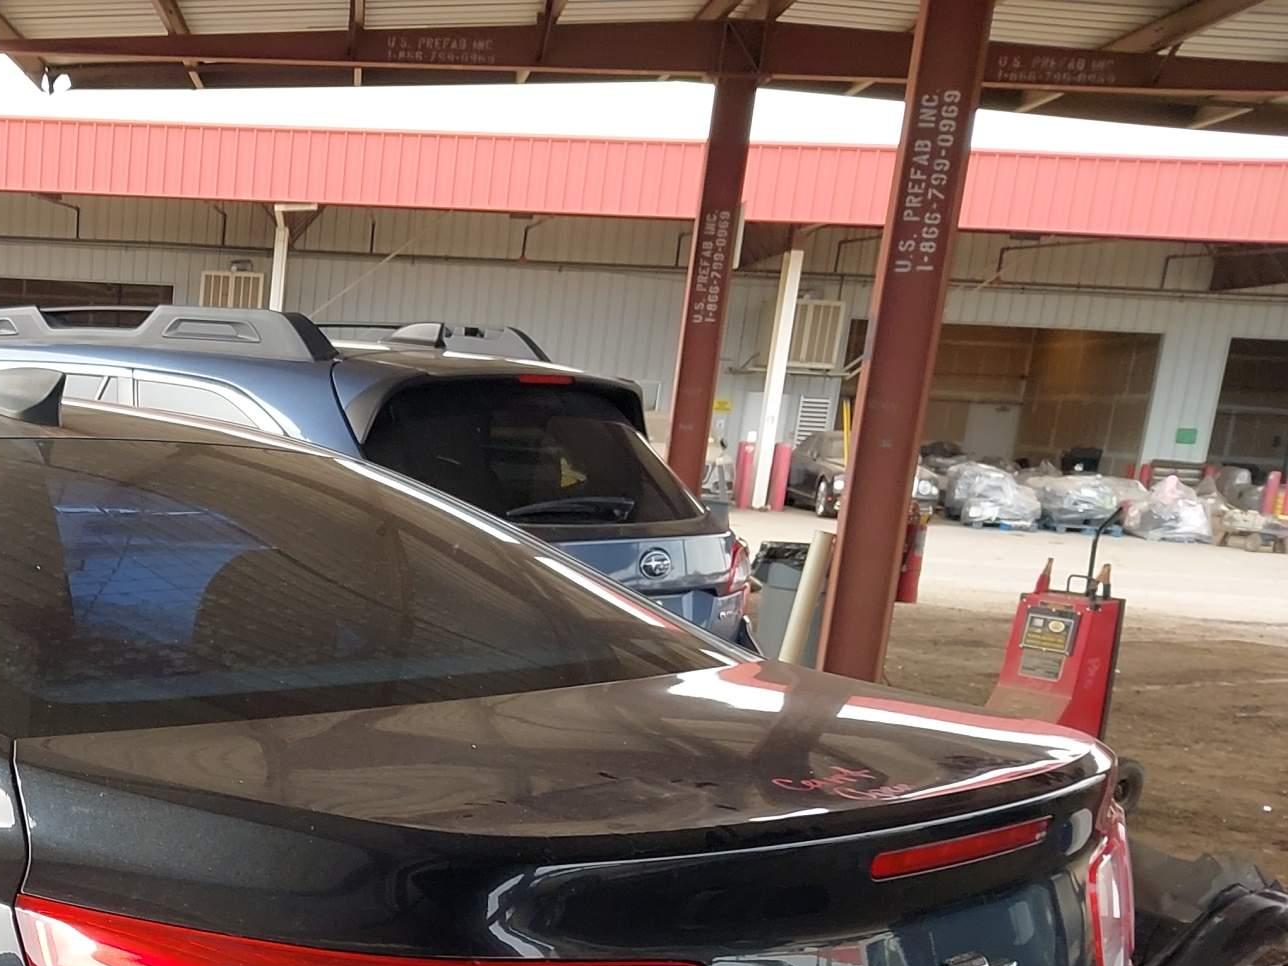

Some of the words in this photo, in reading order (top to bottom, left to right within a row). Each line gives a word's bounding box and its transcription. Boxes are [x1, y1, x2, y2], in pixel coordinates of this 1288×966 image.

[903, 138, 932, 221] PREFAB
[915, 89, 962, 272] 1-866-799-0969
[695, 240, 714, 293] PREFAB
[893, 233, 919, 273] U.S.
